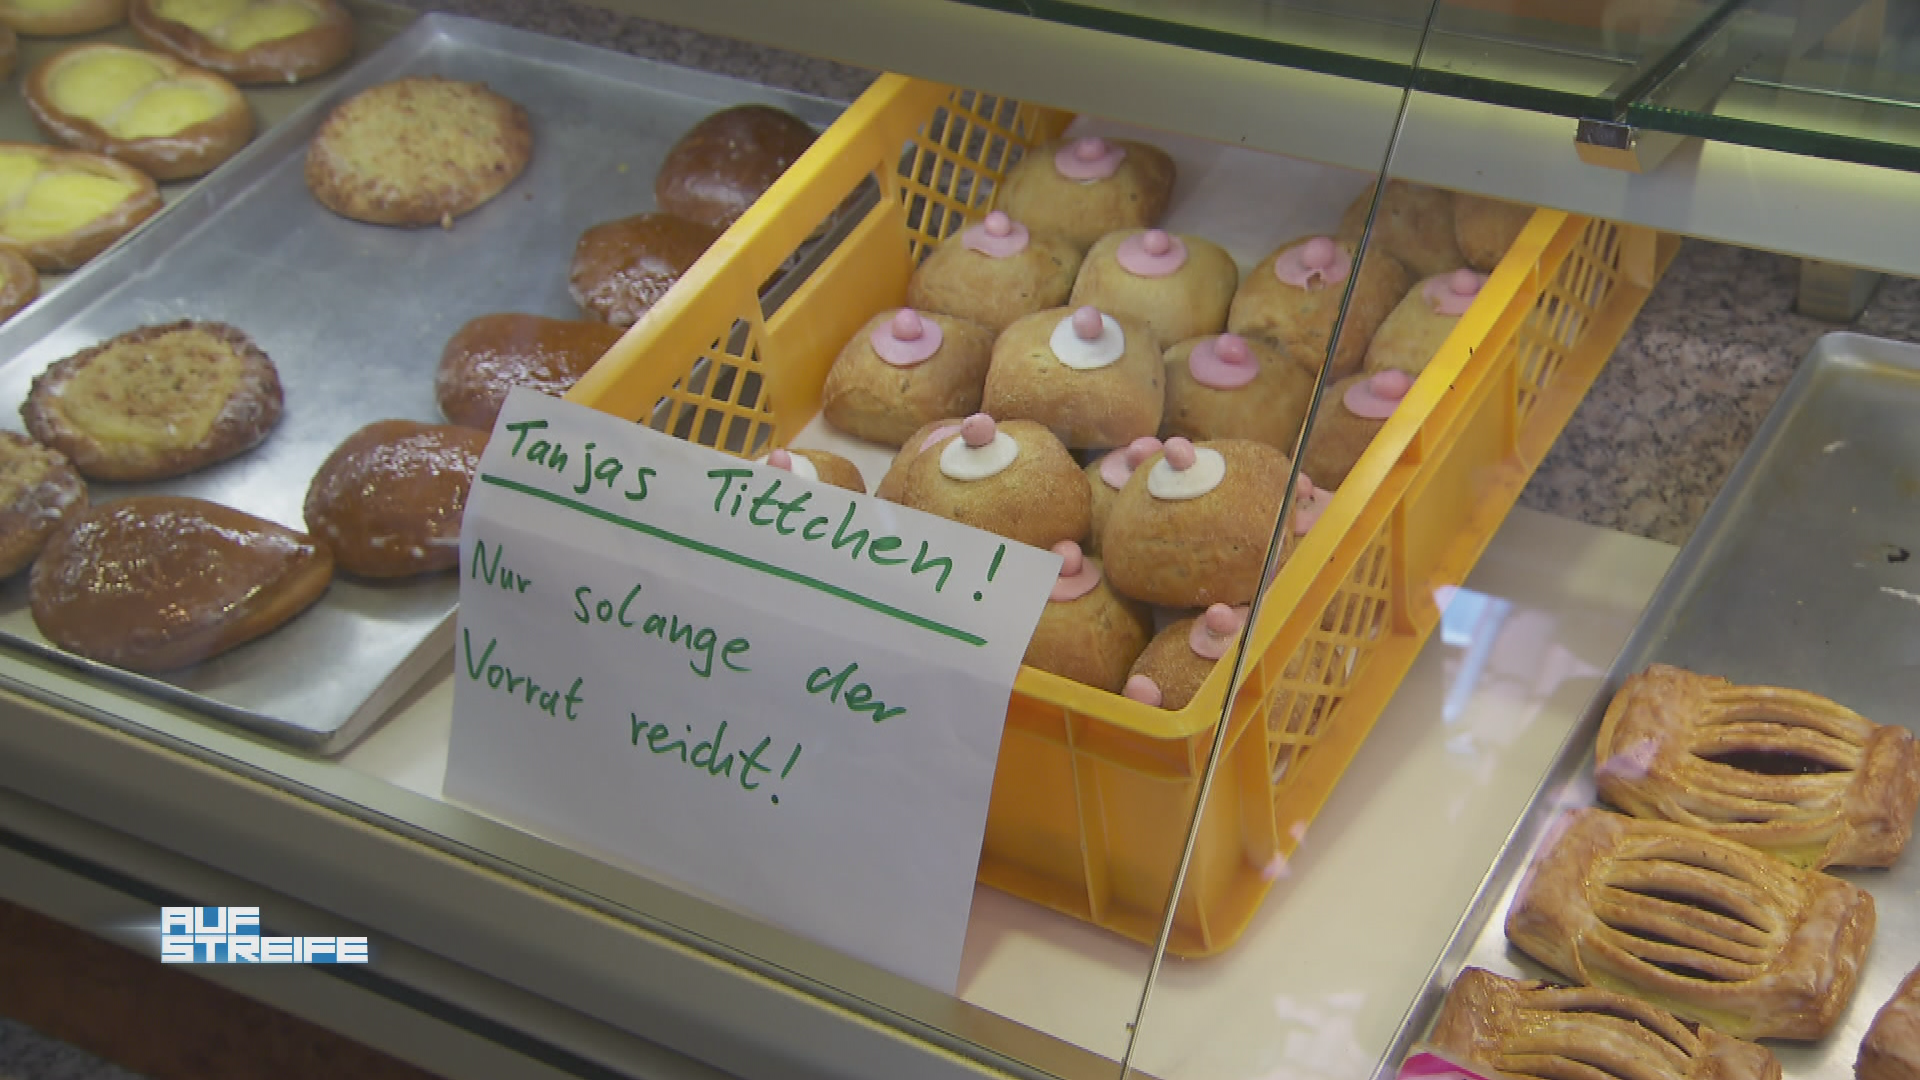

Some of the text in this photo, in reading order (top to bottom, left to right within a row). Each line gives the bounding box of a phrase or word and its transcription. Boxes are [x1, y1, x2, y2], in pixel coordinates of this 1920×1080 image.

[505, 419, 657, 501] Tanjas
[463, 629, 802, 804] Vorrat reicht!
[472, 541, 906, 723] Nur solange der
